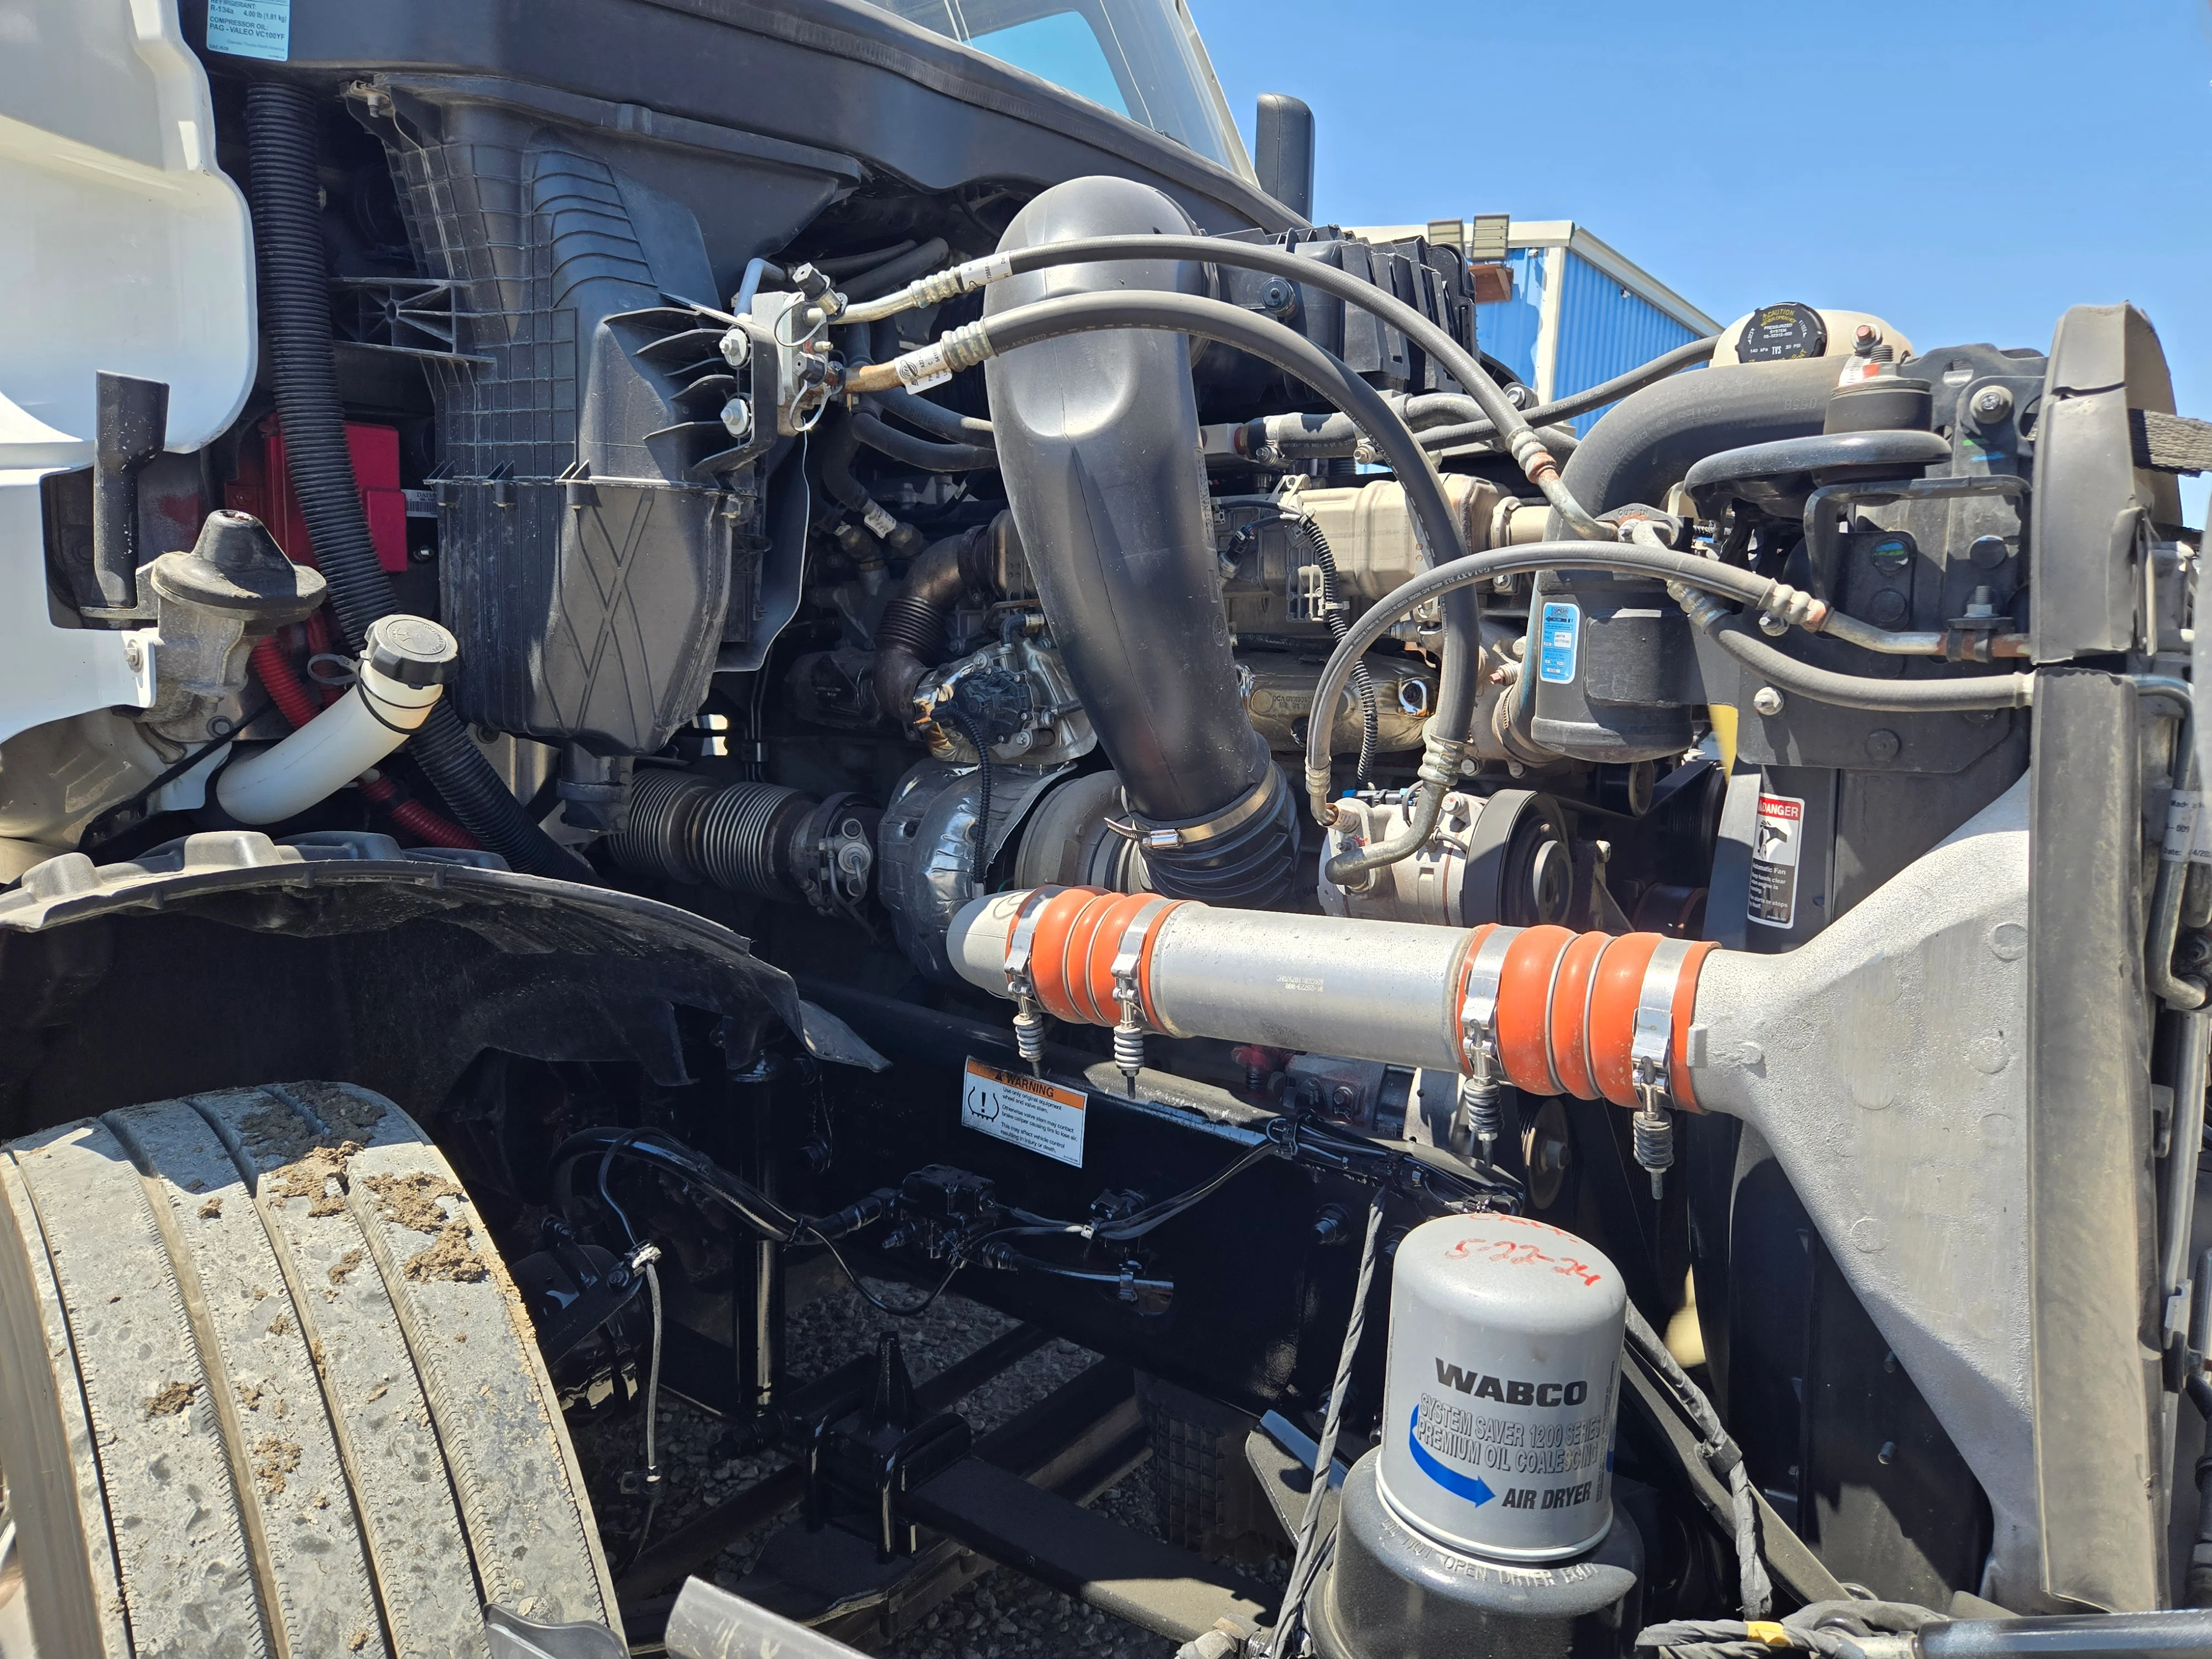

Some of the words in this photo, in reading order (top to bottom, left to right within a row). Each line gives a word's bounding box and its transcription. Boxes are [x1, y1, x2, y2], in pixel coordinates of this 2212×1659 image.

[210, 4, 234, 14] R-134a
[264, 12, 276, 21] (1.81
[279, 14, 287, 23] kg)
[210, 16, 255, 28] COMPRESSOR
[210, 23, 225, 32] PAG
[230, 26, 254, 35] VALEO
[1762, 802, 1798, 817] DANGER
[1006, 1074, 1055, 1098] WARNING
[1002, 1094, 1015, 1103] wheel
[1015, 1097, 1024, 1105] and
[1024, 1101, 1037, 1110] valve
[1011, 1089, 1021, 1098] only
[1022, 1092, 1038, 1103] original
[1039, 1098, 1062, 1111] equipment
[1001, 1104, 1024, 1116] Otherwise
[1024, 1111, 1036, 1120] valve
[1036, 1115, 1047, 1123] stem
[1047, 1119, 1057, 1128] may
[1057, 1124, 1074, 1133] contact
[1001, 1110, 1014, 1120] brake
[1014, 1115, 1029, 1125] caliper
[1029, 1121, 1047, 1133] causing
[1061, 1130, 1070, 1139] lose
[1000, 1130, 1019, 1141] resulting
[1024, 1137, 1037, 1148] injury
[1001, 1121, 1010, 1130] This
[1010, 1125, 1020, 1134] may
[1020, 1129, 1034, 1138] affect
[1034, 1134, 1049, 1143] vehicle
[1049, 1139, 1065, 1149] control
[1435, 1357, 1588, 1407] WABCO
[1420, 1392, 1473, 1437] SYSTEM
[1475, 1416, 1525, 1447] SAVER
[1529, 1423, 1563, 1449] 1200
[1565, 1415, 1601, 1446] SERIES
[1417, 1416, 1481, 1465] PREMIUM
[1484, 1444, 1511, 1472] OIL
[1515, 1441, 1598, 1474] COALESCING
[1501, 1488, 1537, 1510] AIR
[1540, 1480, 1593, 1510] DRYER
[1401, 1535, 1436, 1561] NOT
[1443, 1555, 1488, 1582] OPEN
[1498, 1569, 1556, 1587] DRYER
